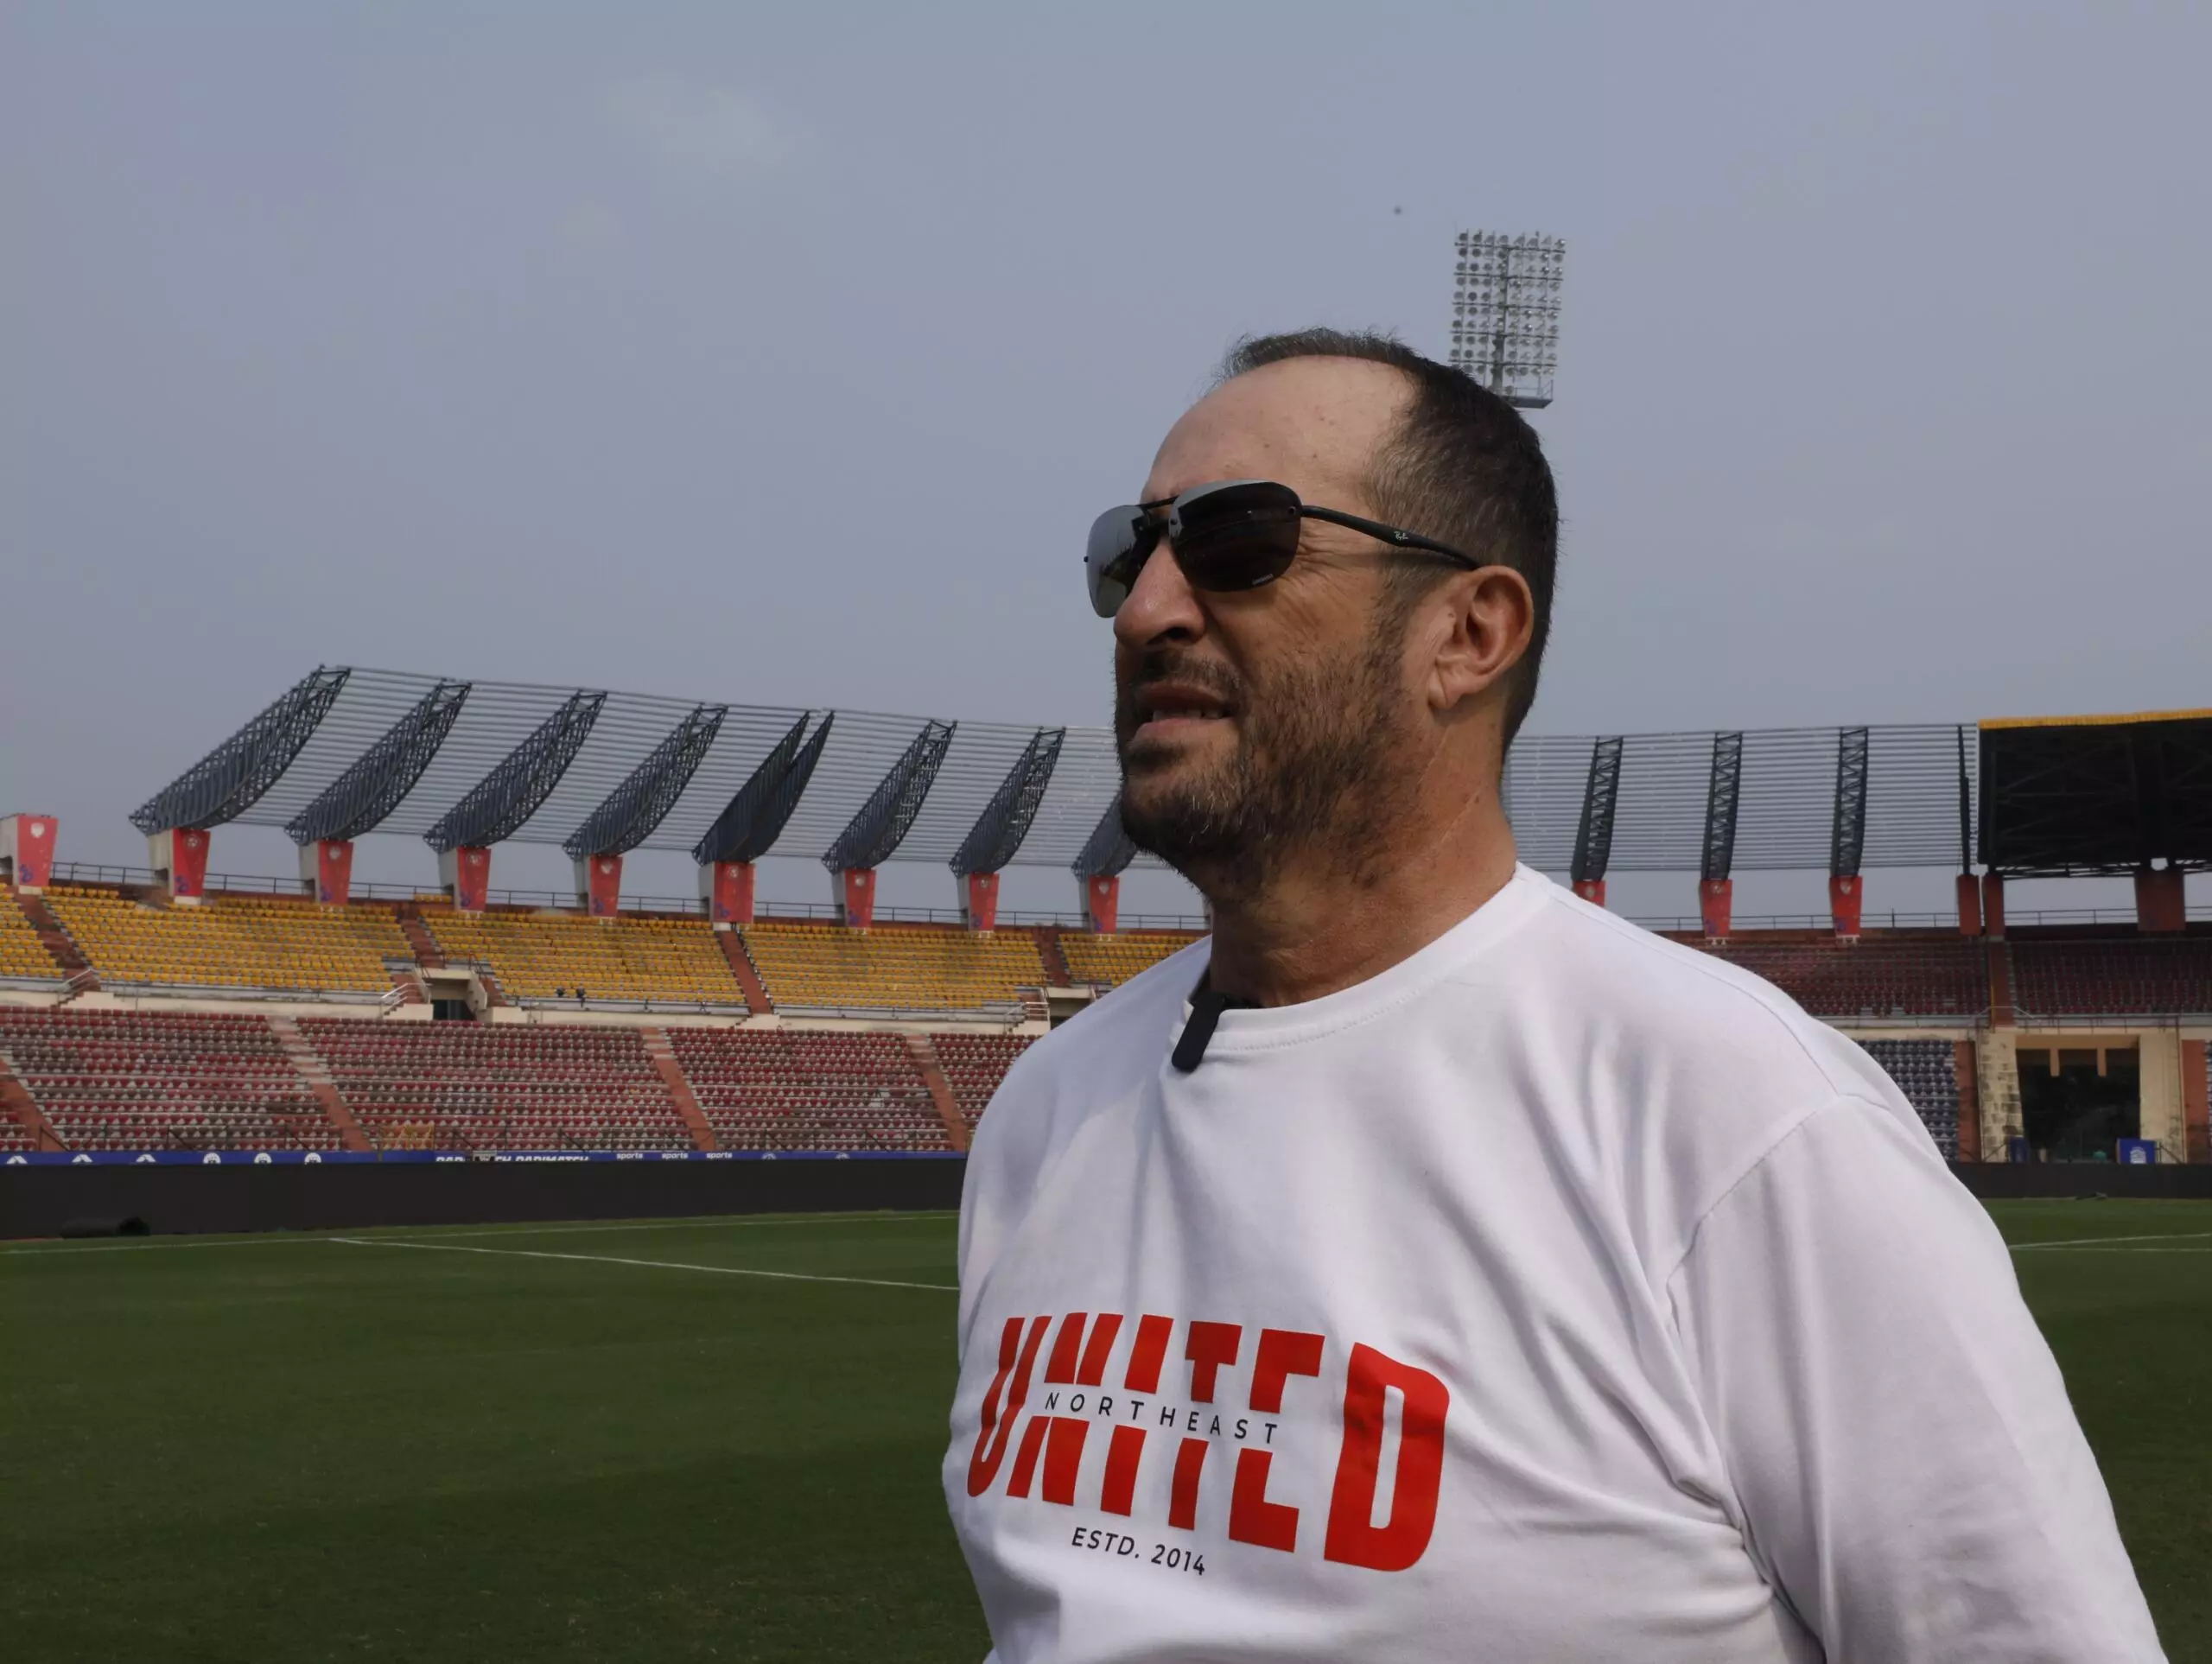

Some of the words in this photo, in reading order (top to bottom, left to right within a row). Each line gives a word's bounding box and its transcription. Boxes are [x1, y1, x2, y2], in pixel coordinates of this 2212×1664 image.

[616, 1152, 643, 1160] sports
[706, 1151, 733, 1159] sports
[967, 1312, 1450, 1572] UNITED
[1045, 1392, 1277, 1444] NORTHEAST
[1071, 1527, 1139, 1559] ESTD.
[1151, 1544, 1205, 1576] 2014
